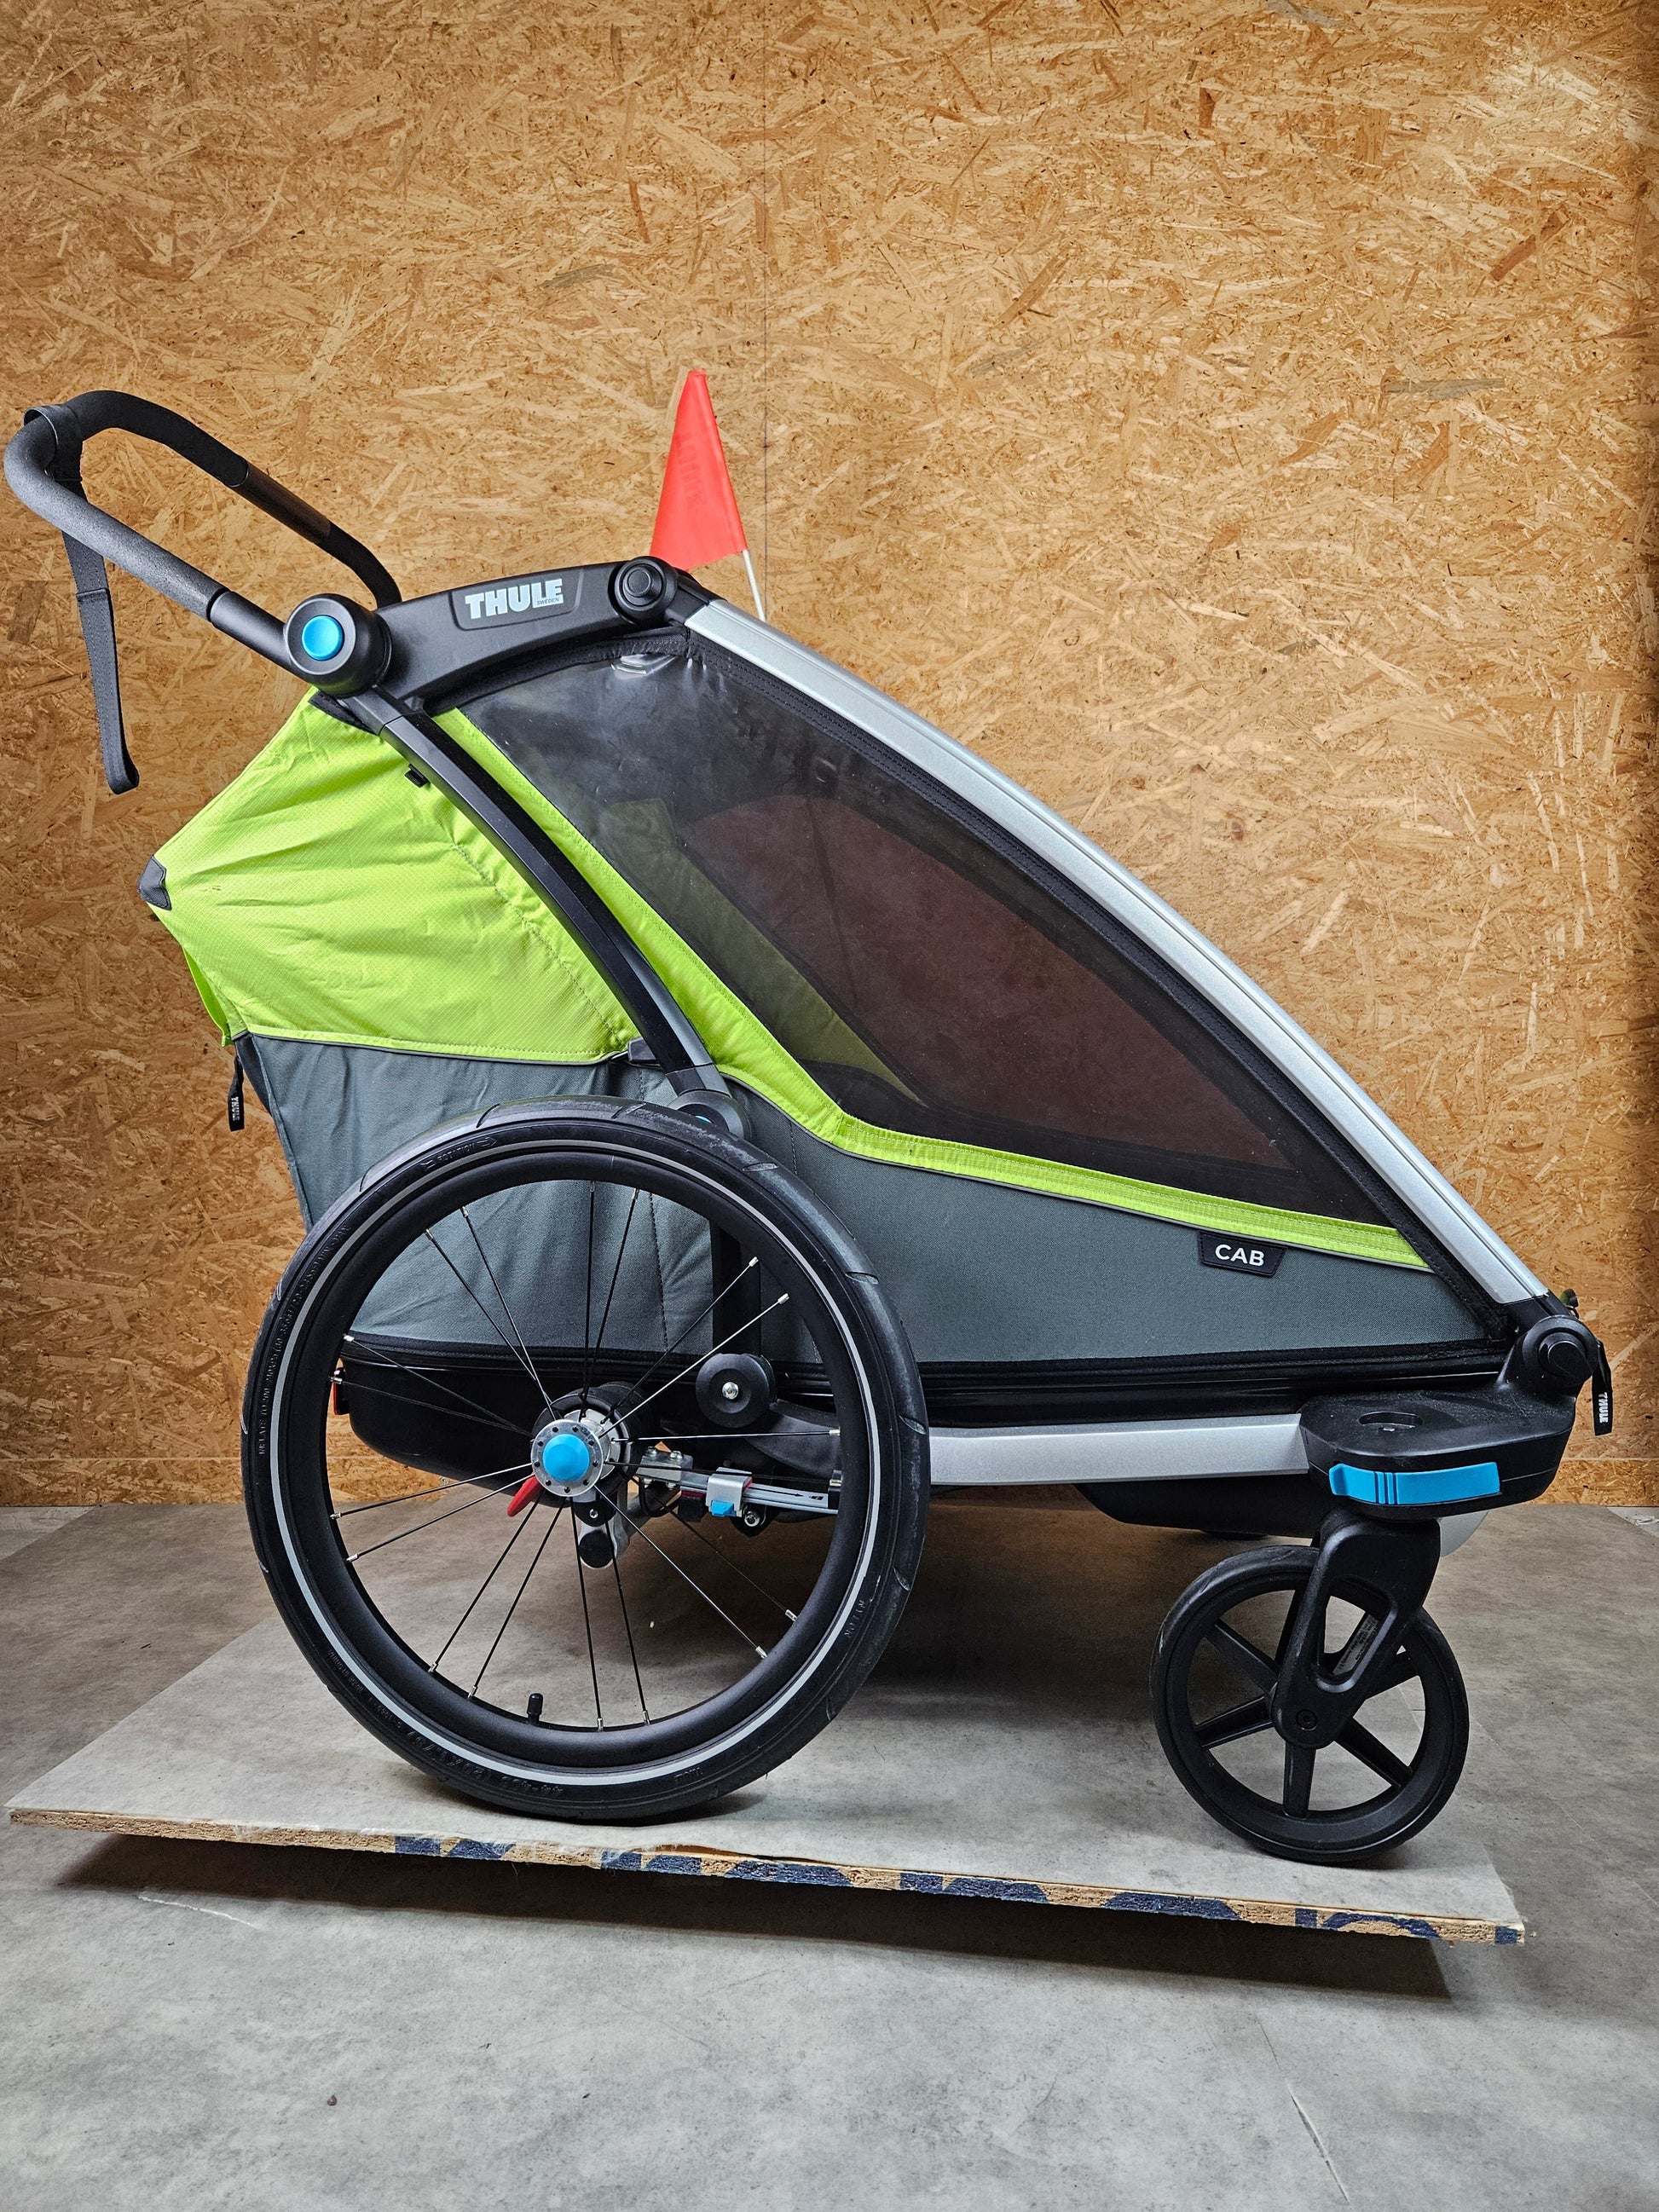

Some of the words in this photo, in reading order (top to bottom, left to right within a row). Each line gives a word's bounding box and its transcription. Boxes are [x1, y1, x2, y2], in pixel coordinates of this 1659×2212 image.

[465, 578, 564, 620] THULE
[231, 1097, 240, 1121] THULE
[436, 1142, 477, 1163] ROTATION
[1216, 1245, 1264, 1266] CAB
[1599, 1393, 1608, 1423] THULE
